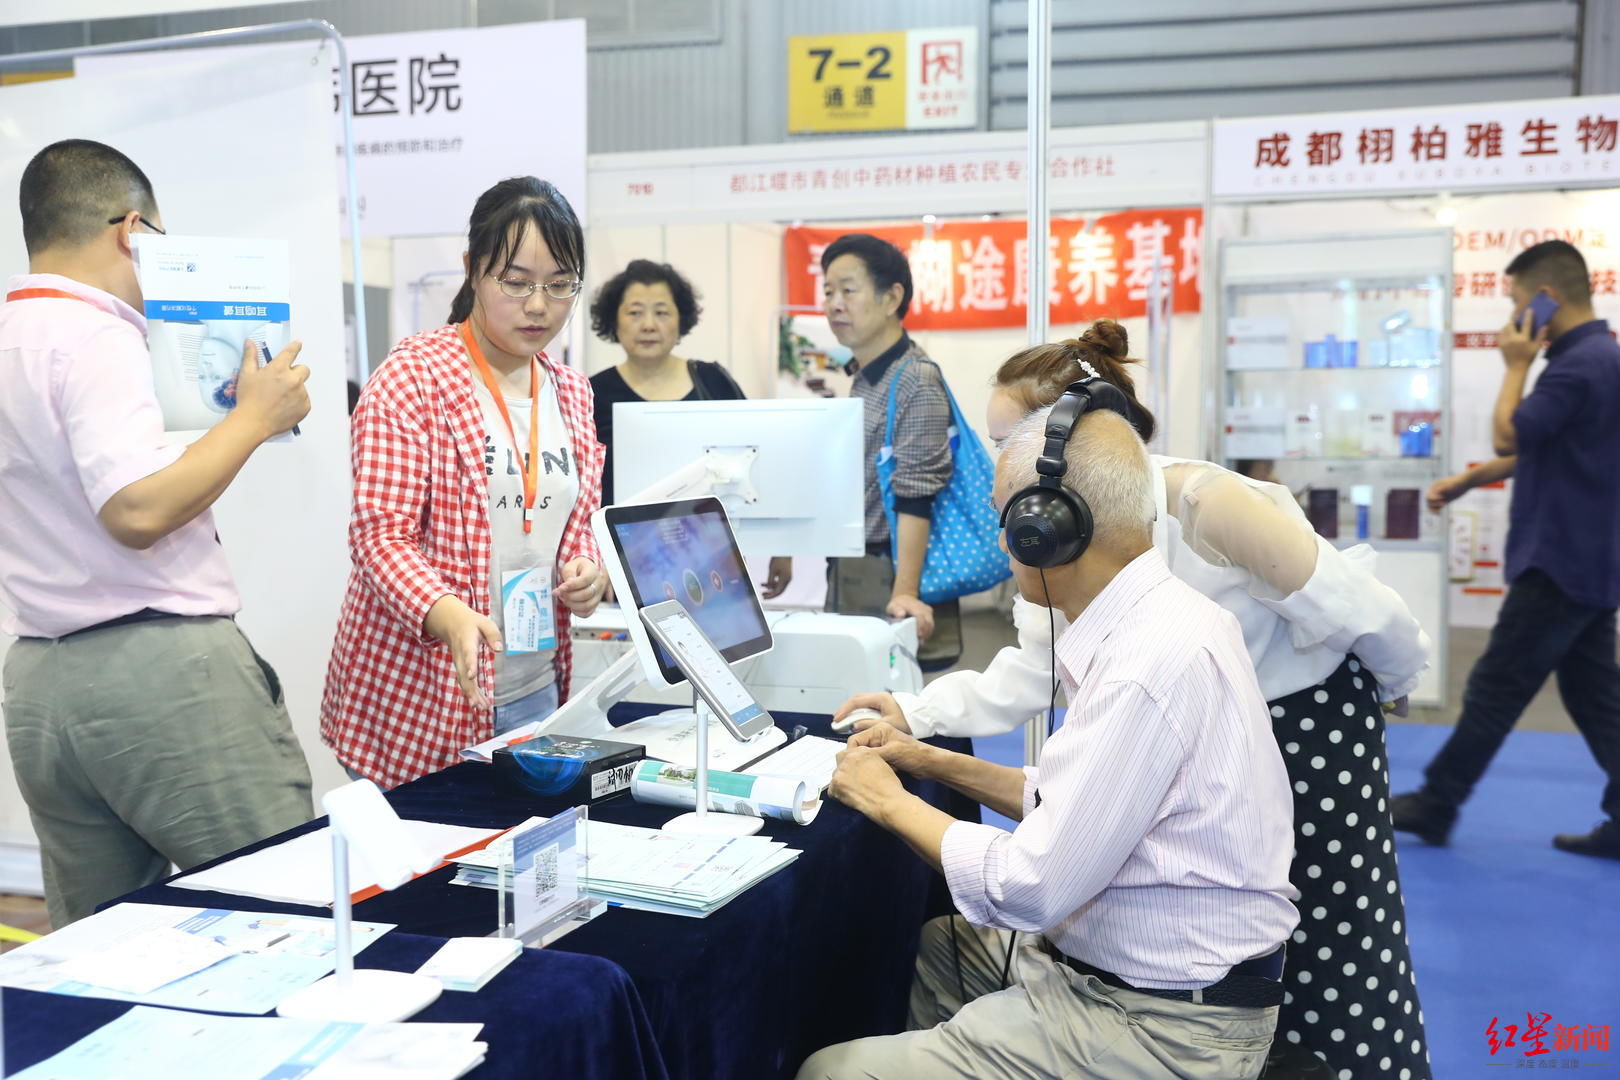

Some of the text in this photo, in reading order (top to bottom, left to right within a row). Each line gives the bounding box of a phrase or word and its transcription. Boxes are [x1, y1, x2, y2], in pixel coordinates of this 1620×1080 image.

[808, 46, 892, 82] 7-2
[825, 85, 875, 108] 通道
[1254, 115, 1618, 168] 成都栩柏雅生物
[730, 154, 1115, 193] 都江堰市青创中药材种植农民专合作社
[488, 494, 552, 509] ARS
